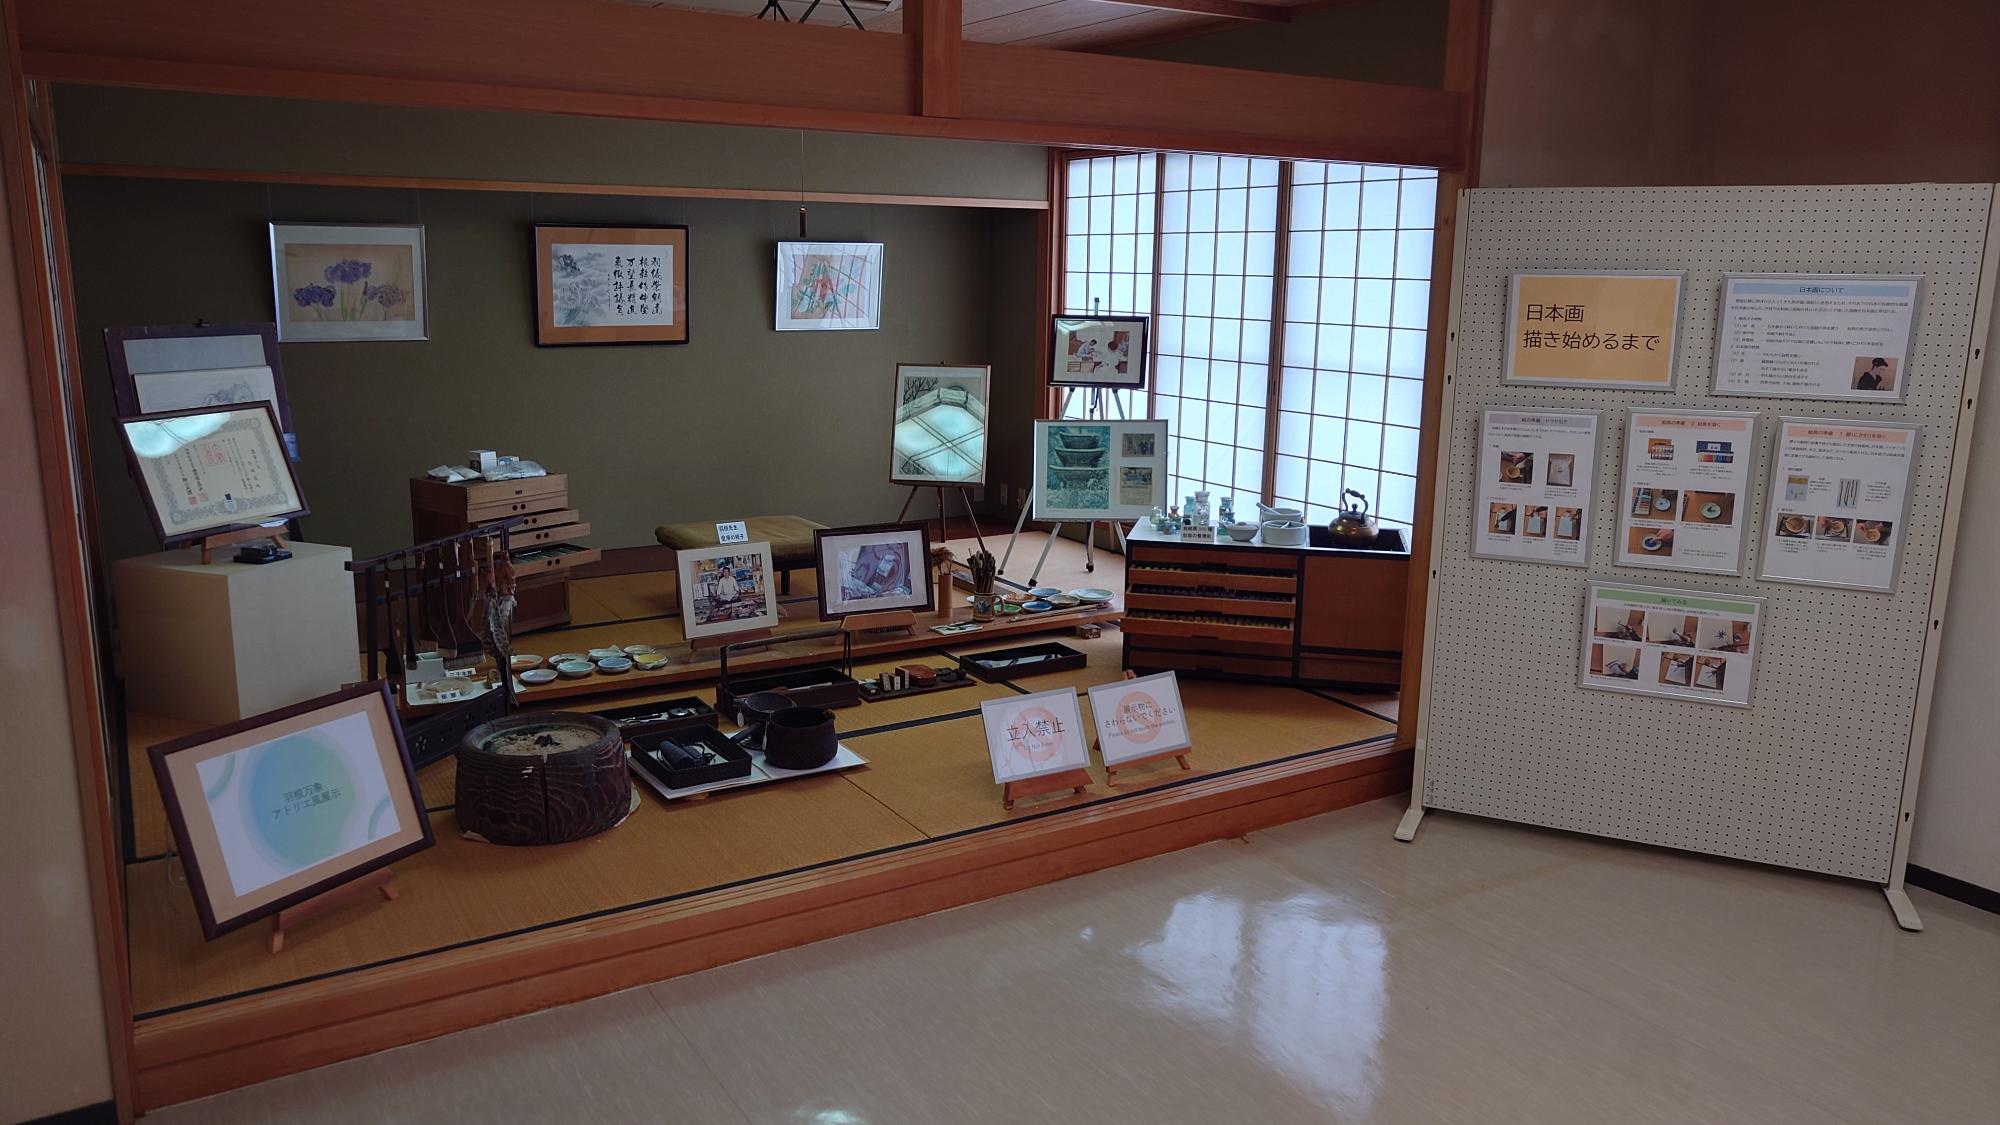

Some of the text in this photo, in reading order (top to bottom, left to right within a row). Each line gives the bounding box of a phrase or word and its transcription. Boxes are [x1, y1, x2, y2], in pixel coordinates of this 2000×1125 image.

[1799, 286, 1845, 294] 日本画について
[1526, 303, 1585, 323] 日本画
[1523, 329, 1660, 351] 描き始めるまで
[1104, 707, 1176, 729] さわらないでください
[1123, 703, 1153, 714] 展示物に
[1007, 716, 1065, 742] 立入禁止
[271, 786, 342, 820] アトリエ風展示
[282, 782, 324, 803] 羽根万象
